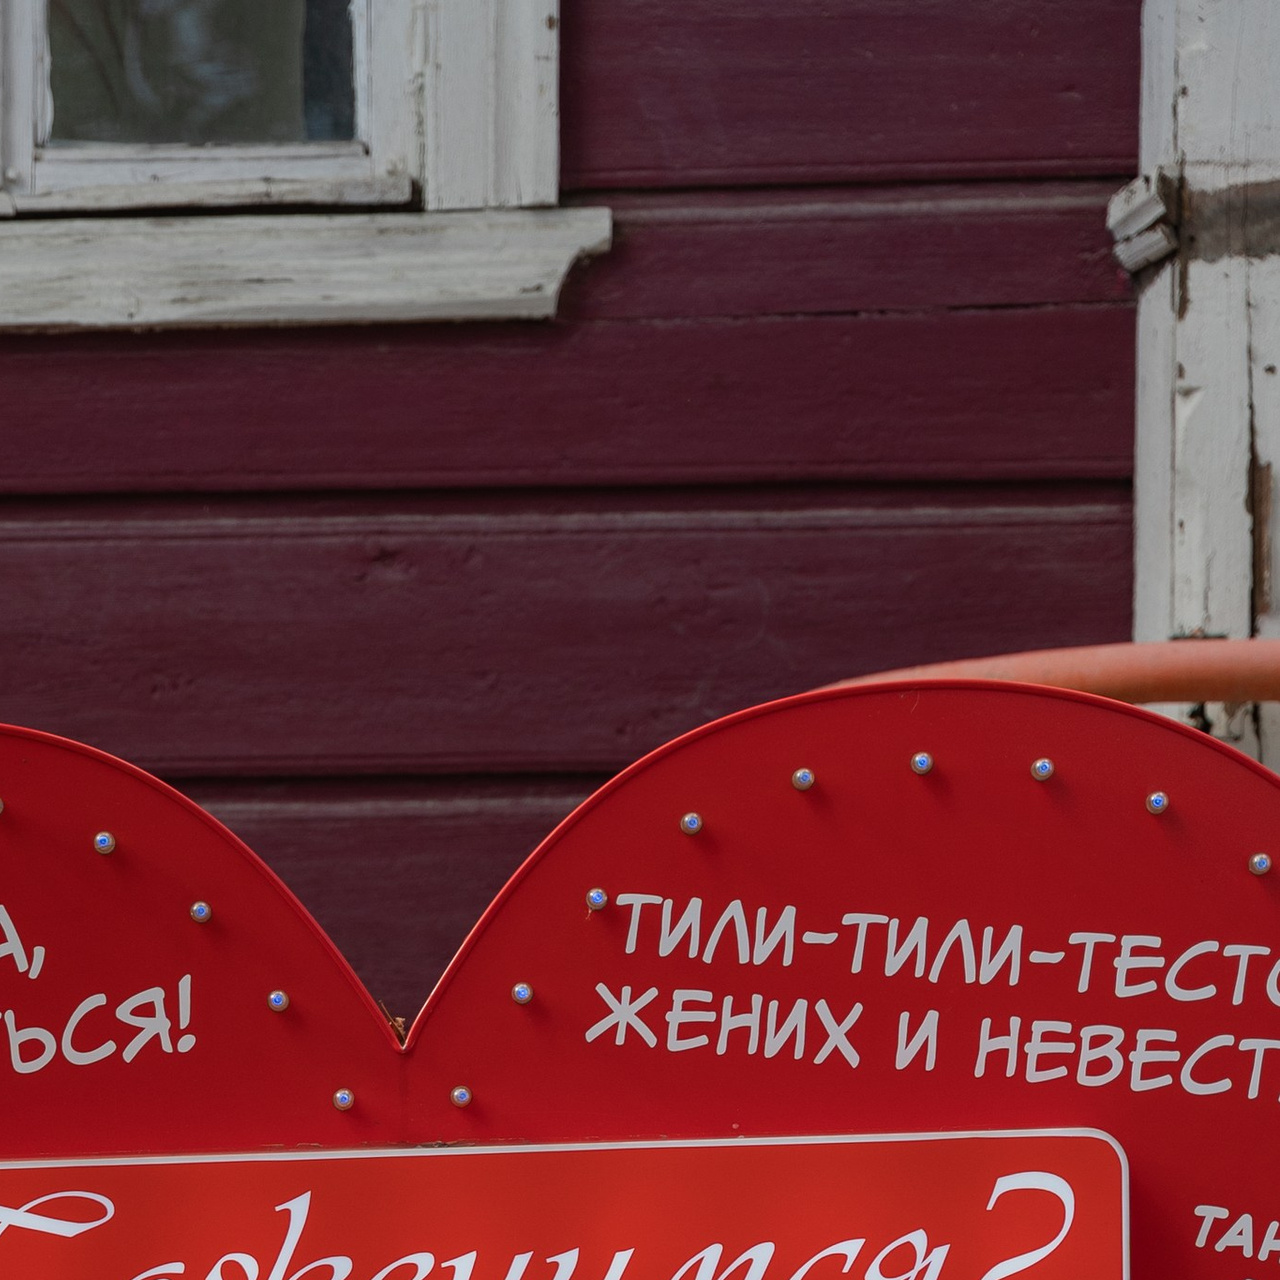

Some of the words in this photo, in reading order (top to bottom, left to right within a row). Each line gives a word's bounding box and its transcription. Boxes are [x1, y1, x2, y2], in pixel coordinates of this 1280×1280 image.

[615, 893, 1280, 1007] ТИЛИ-ТИЛИ-ТЕСТ
[585, 982, 864, 1069] ЖЕНИХ
[895, 1009, 940, 1072] И
[974, 1015, 1280, 1102] НЕВЕСТ
